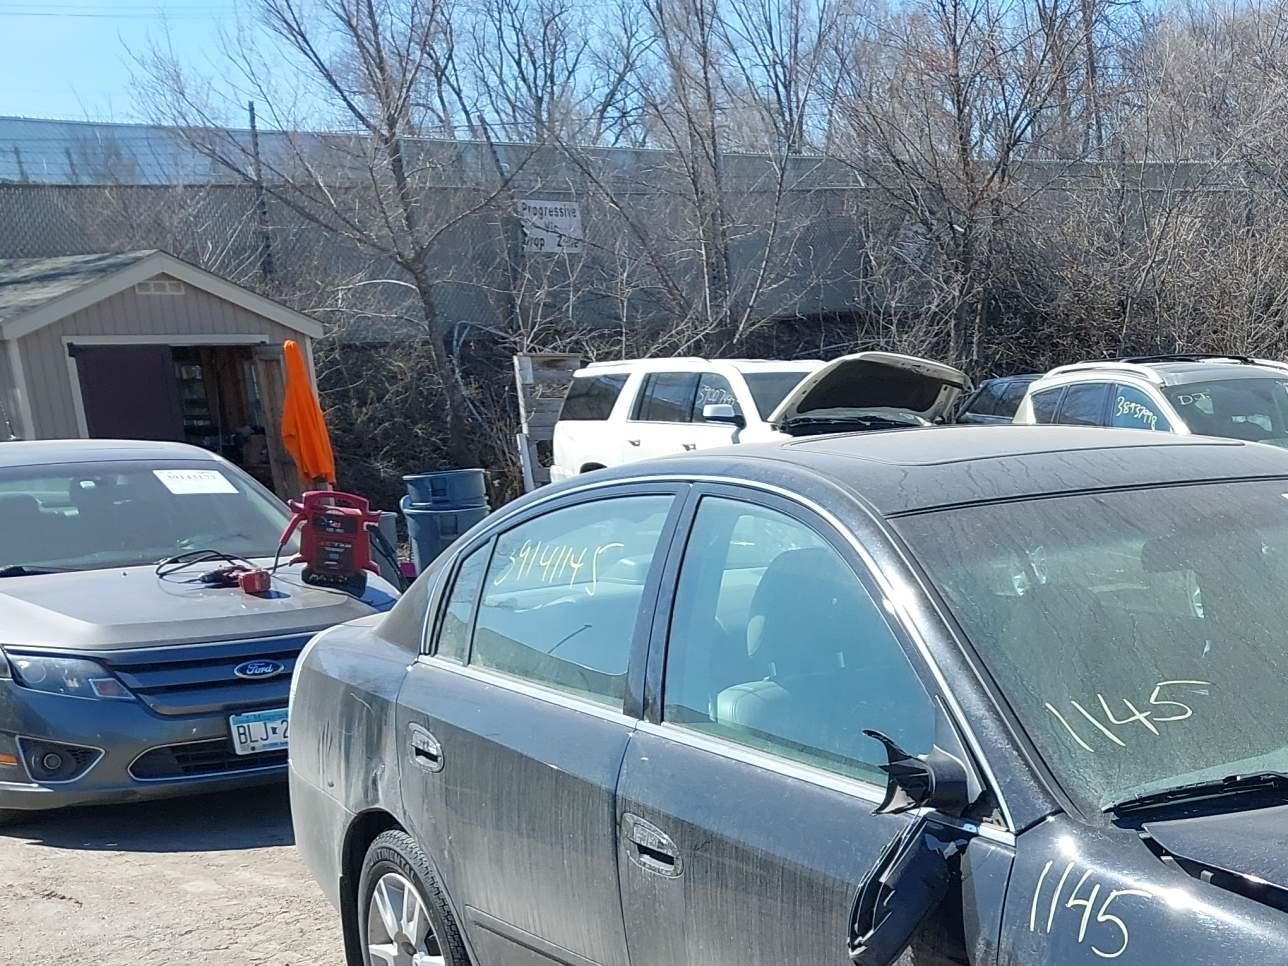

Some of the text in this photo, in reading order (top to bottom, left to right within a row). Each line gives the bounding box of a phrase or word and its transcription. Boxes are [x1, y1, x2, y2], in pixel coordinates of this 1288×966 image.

[521, 202, 577, 220] Progressive
[246, 663, 273, 675] Ford
[1045, 680, 1213, 753] 1145
[236, 721, 270, 745] BLJ
[1029, 859, 1152, 959] 1145
